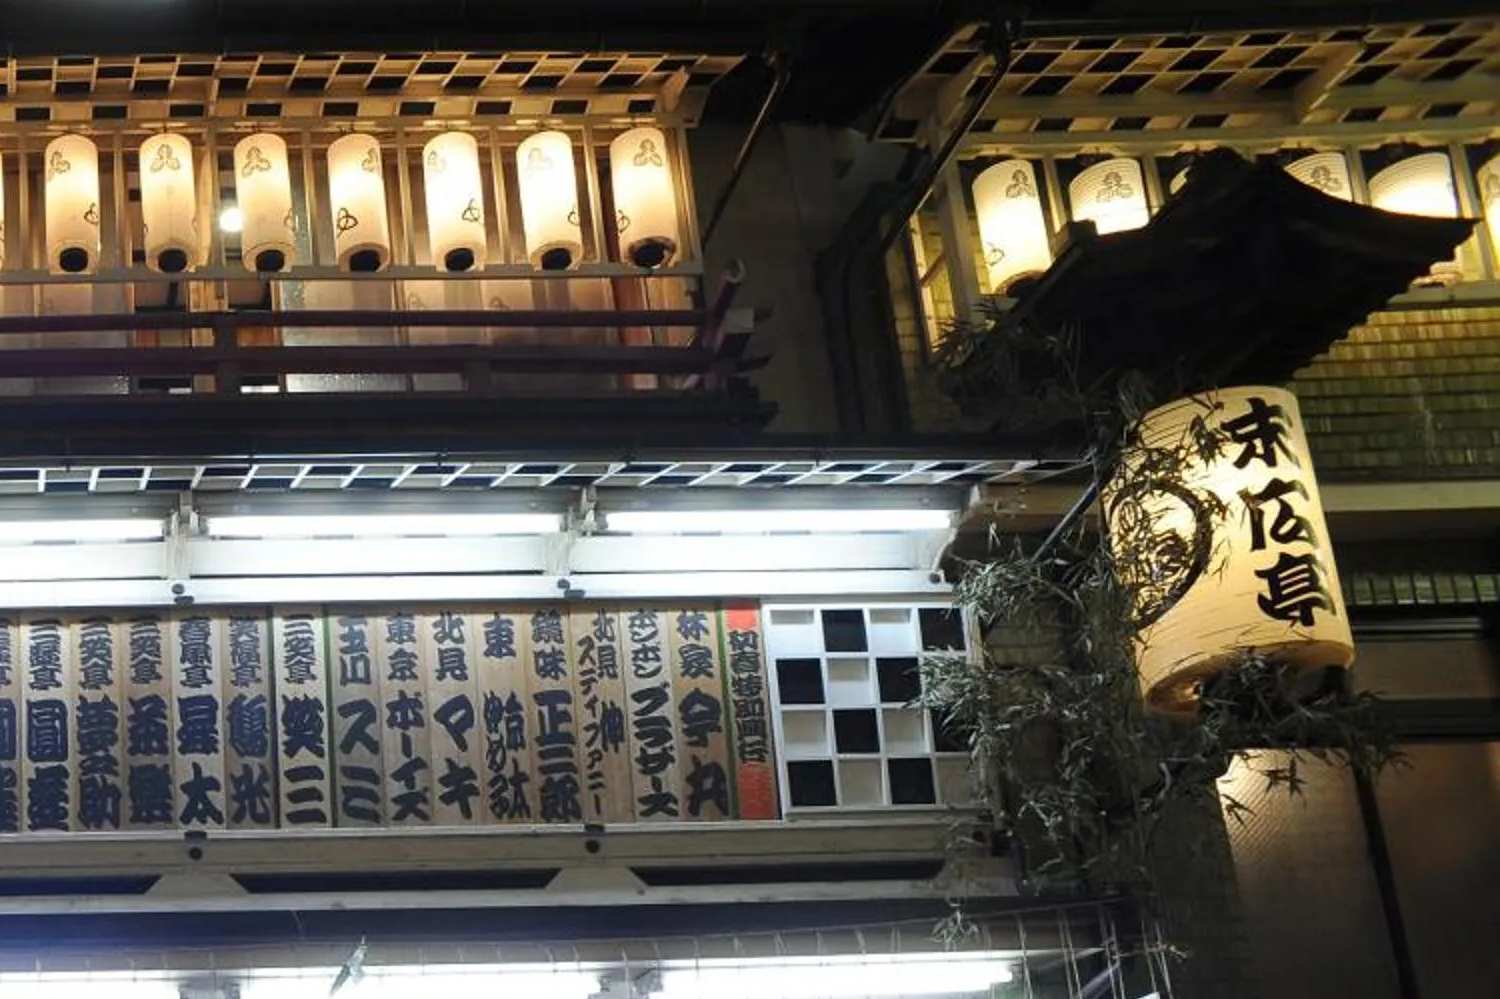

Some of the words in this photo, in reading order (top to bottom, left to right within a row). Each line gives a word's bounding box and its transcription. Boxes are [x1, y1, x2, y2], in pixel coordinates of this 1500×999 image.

[386, 612, 432, 822] 東京ボーイズ
[432, 611, 481, 820] 北見マキ
